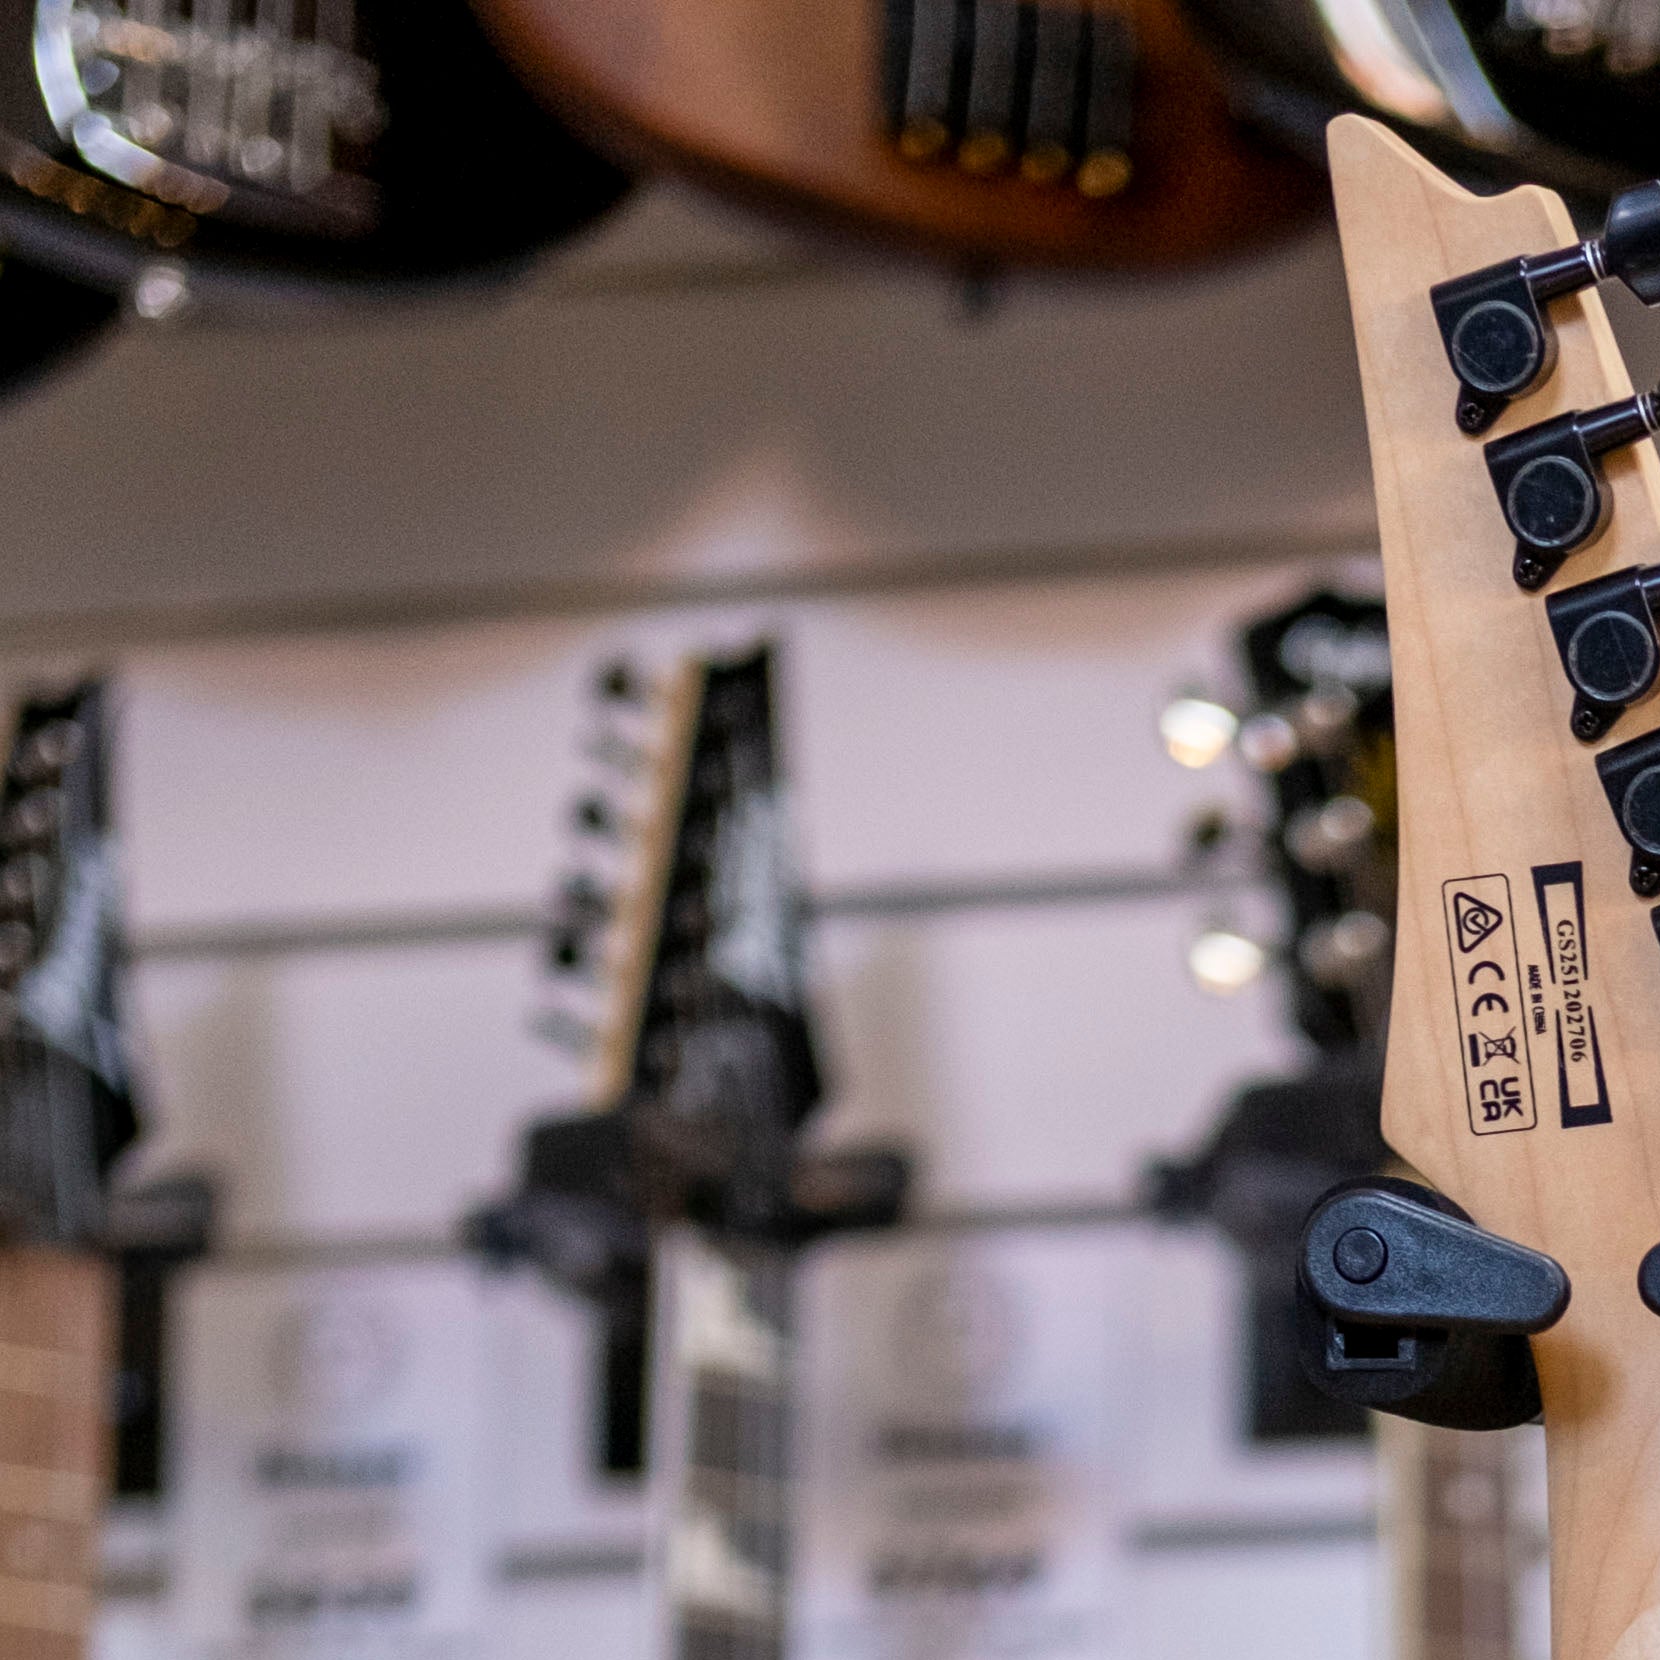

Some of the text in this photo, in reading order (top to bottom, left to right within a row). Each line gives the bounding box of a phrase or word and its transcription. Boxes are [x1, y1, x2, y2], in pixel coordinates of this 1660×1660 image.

[1469, 960, 1509, 1017] CE
[1528, 964, 1543, 990] MADE
[1556, 919, 1588, 1063] GS251202706
[1531, 993, 1543, 1004] IN
[1480, 1079, 1500, 1122] CA
[1500, 1076, 1524, 1118] UK
